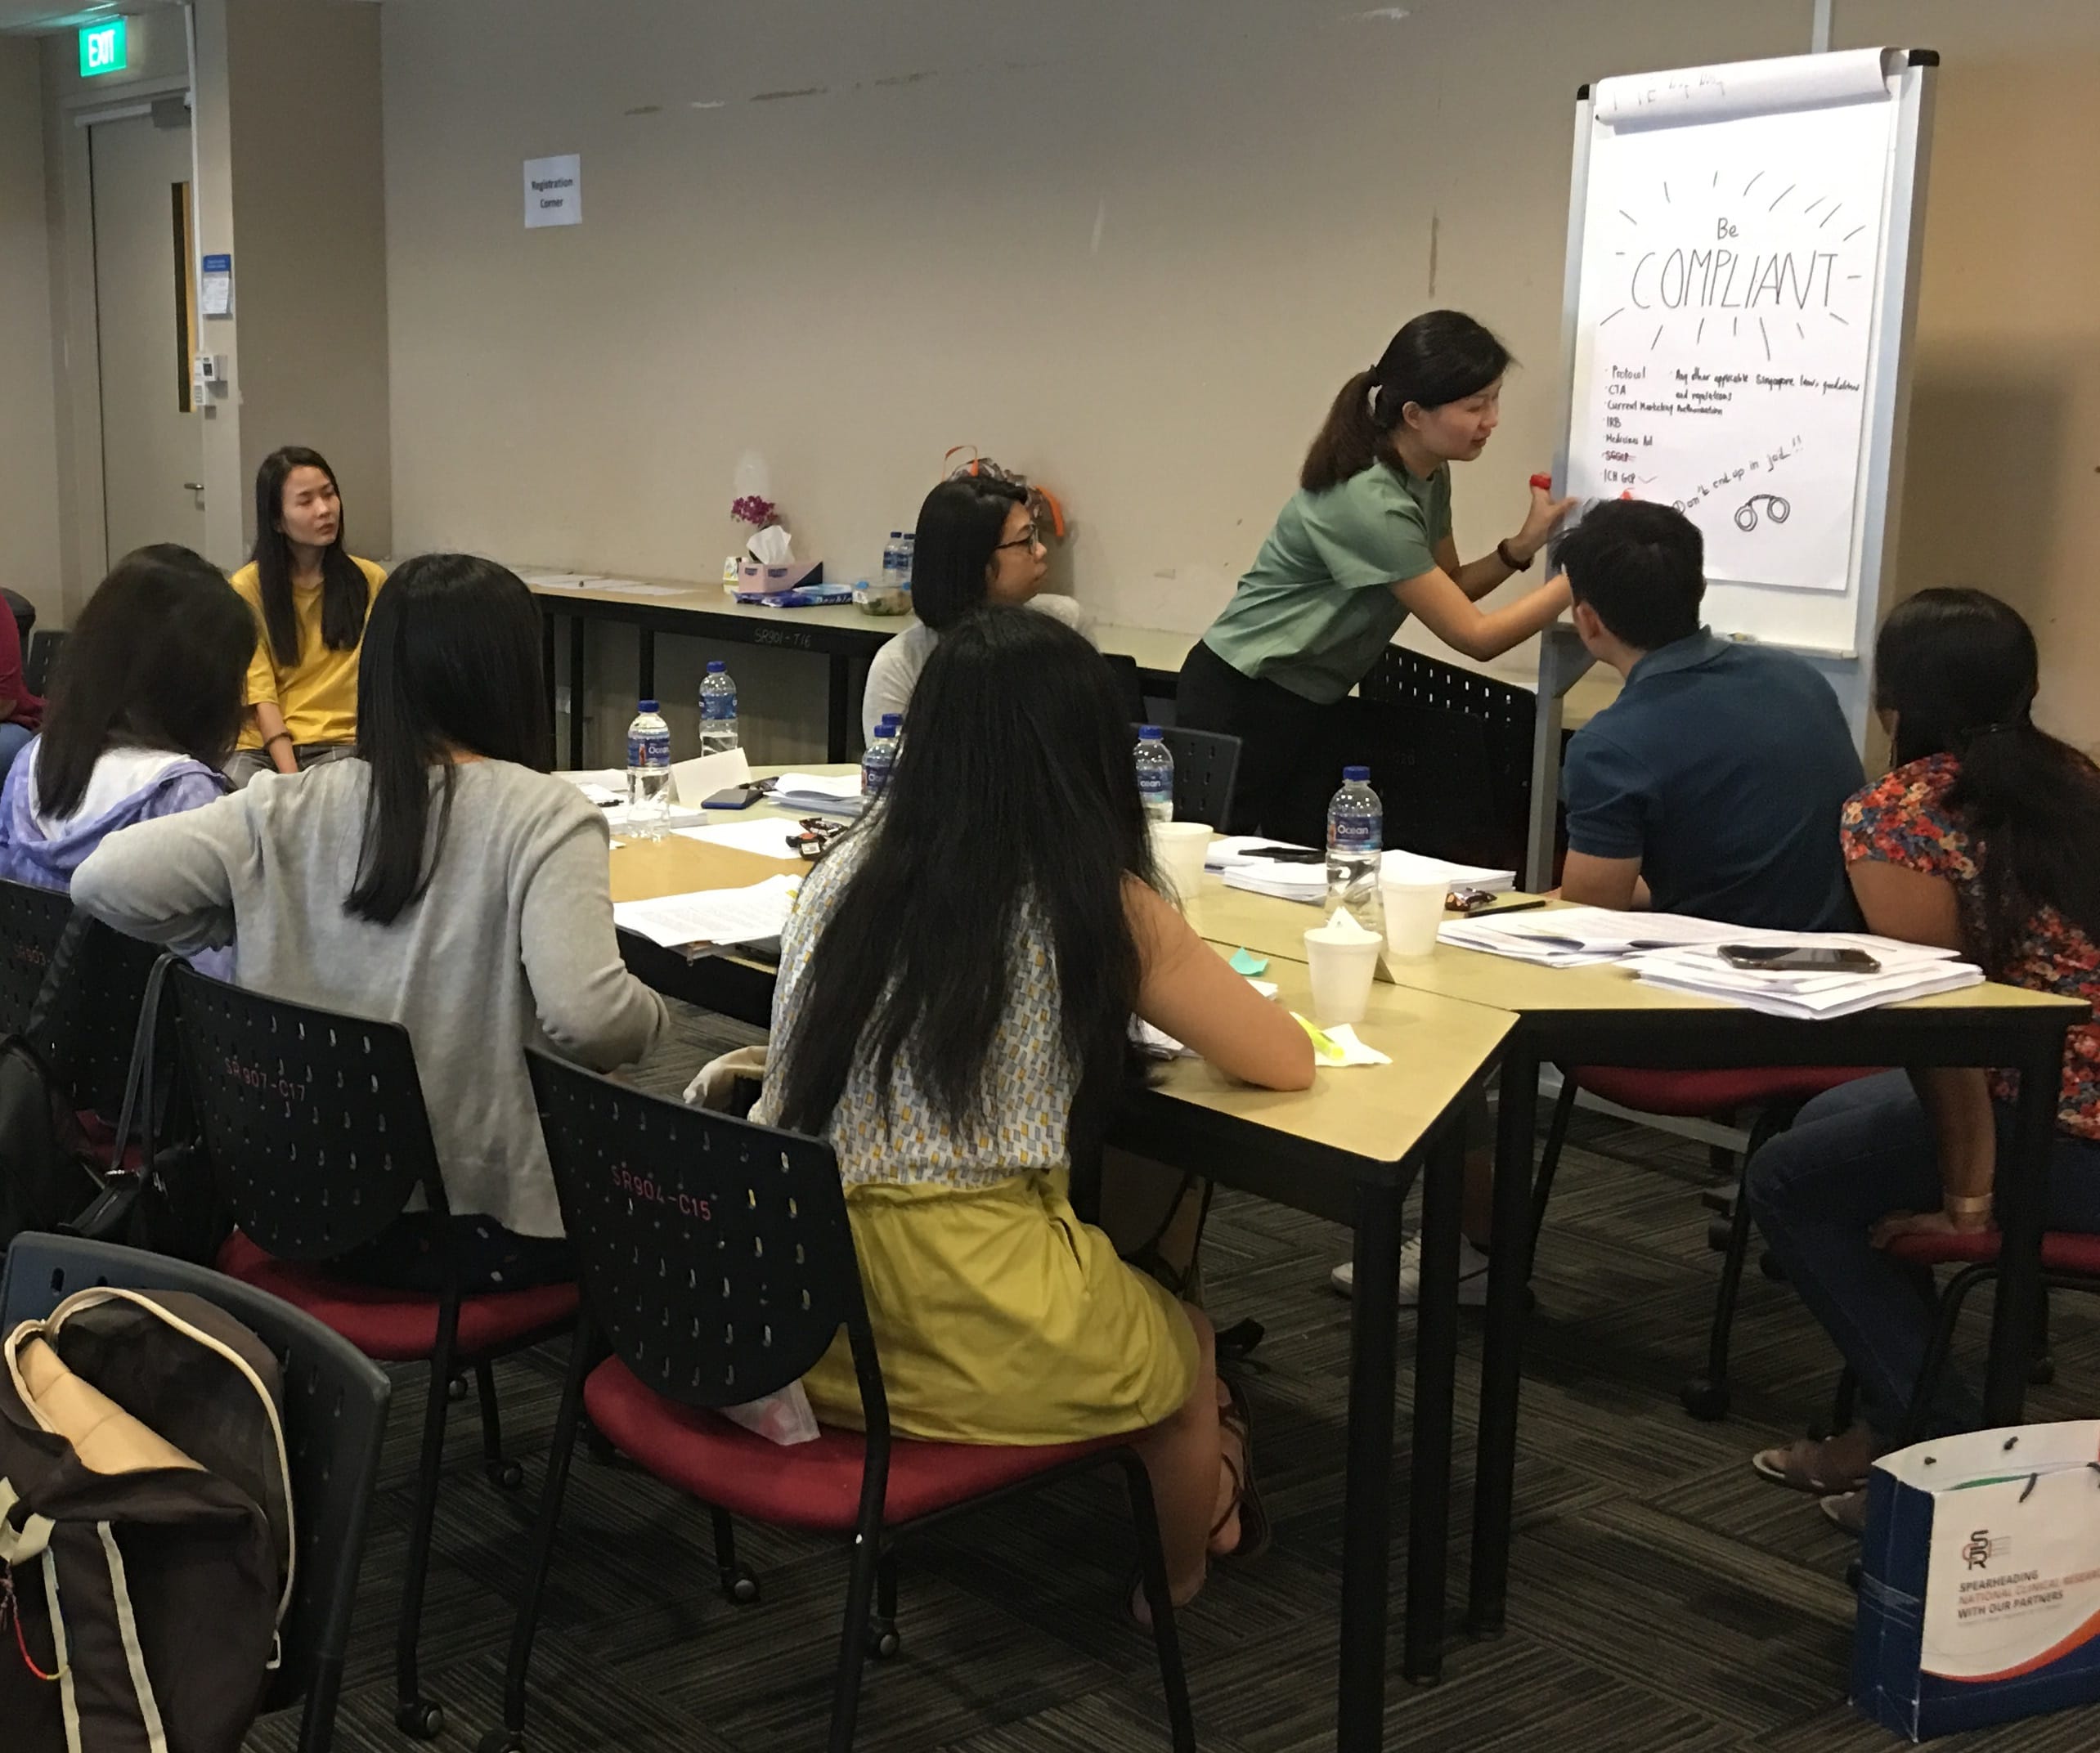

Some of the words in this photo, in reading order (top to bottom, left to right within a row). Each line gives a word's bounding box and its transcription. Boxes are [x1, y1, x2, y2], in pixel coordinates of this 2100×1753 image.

[88, 29, 115, 68] EXIT
[532, 178, 573, 192] Registration
[541, 199, 563, 208] Corner
[1717, 217, 1739, 240] Be
[1631, 248, 1838, 310] COMPLIANT
[1612, 365, 1645, 379] Protocol
[1676, 369, 1688, 385] Any
[1691, 366, 1711, 381] other
[1608, 384, 1627, 395] CTA
[1676, 388, 1688, 399] and
[1607, 400, 1637, 410] Current
[1606, 416, 1622, 428] IRB
[1604, 469, 1618, 482] ICH
[1621, 473, 1636, 484] GCP
[1712, 473, 1731, 489] end
[1732, 468, 1745, 482] up
[1749, 461, 1759, 470] in
[1338, 824, 1369, 834] Ocean
[1959, 1569, 2039, 1593] SPEARHEADING
[1959, 1589, 2012, 1605] NATIONAL
[2014, 1578, 2060, 1595] CLINICAL
[1958, 1606, 1986, 1619] WITH
[1988, 1601, 2011, 1614] OUR
[2013, 1589, 2063, 1608] PARTNERS
